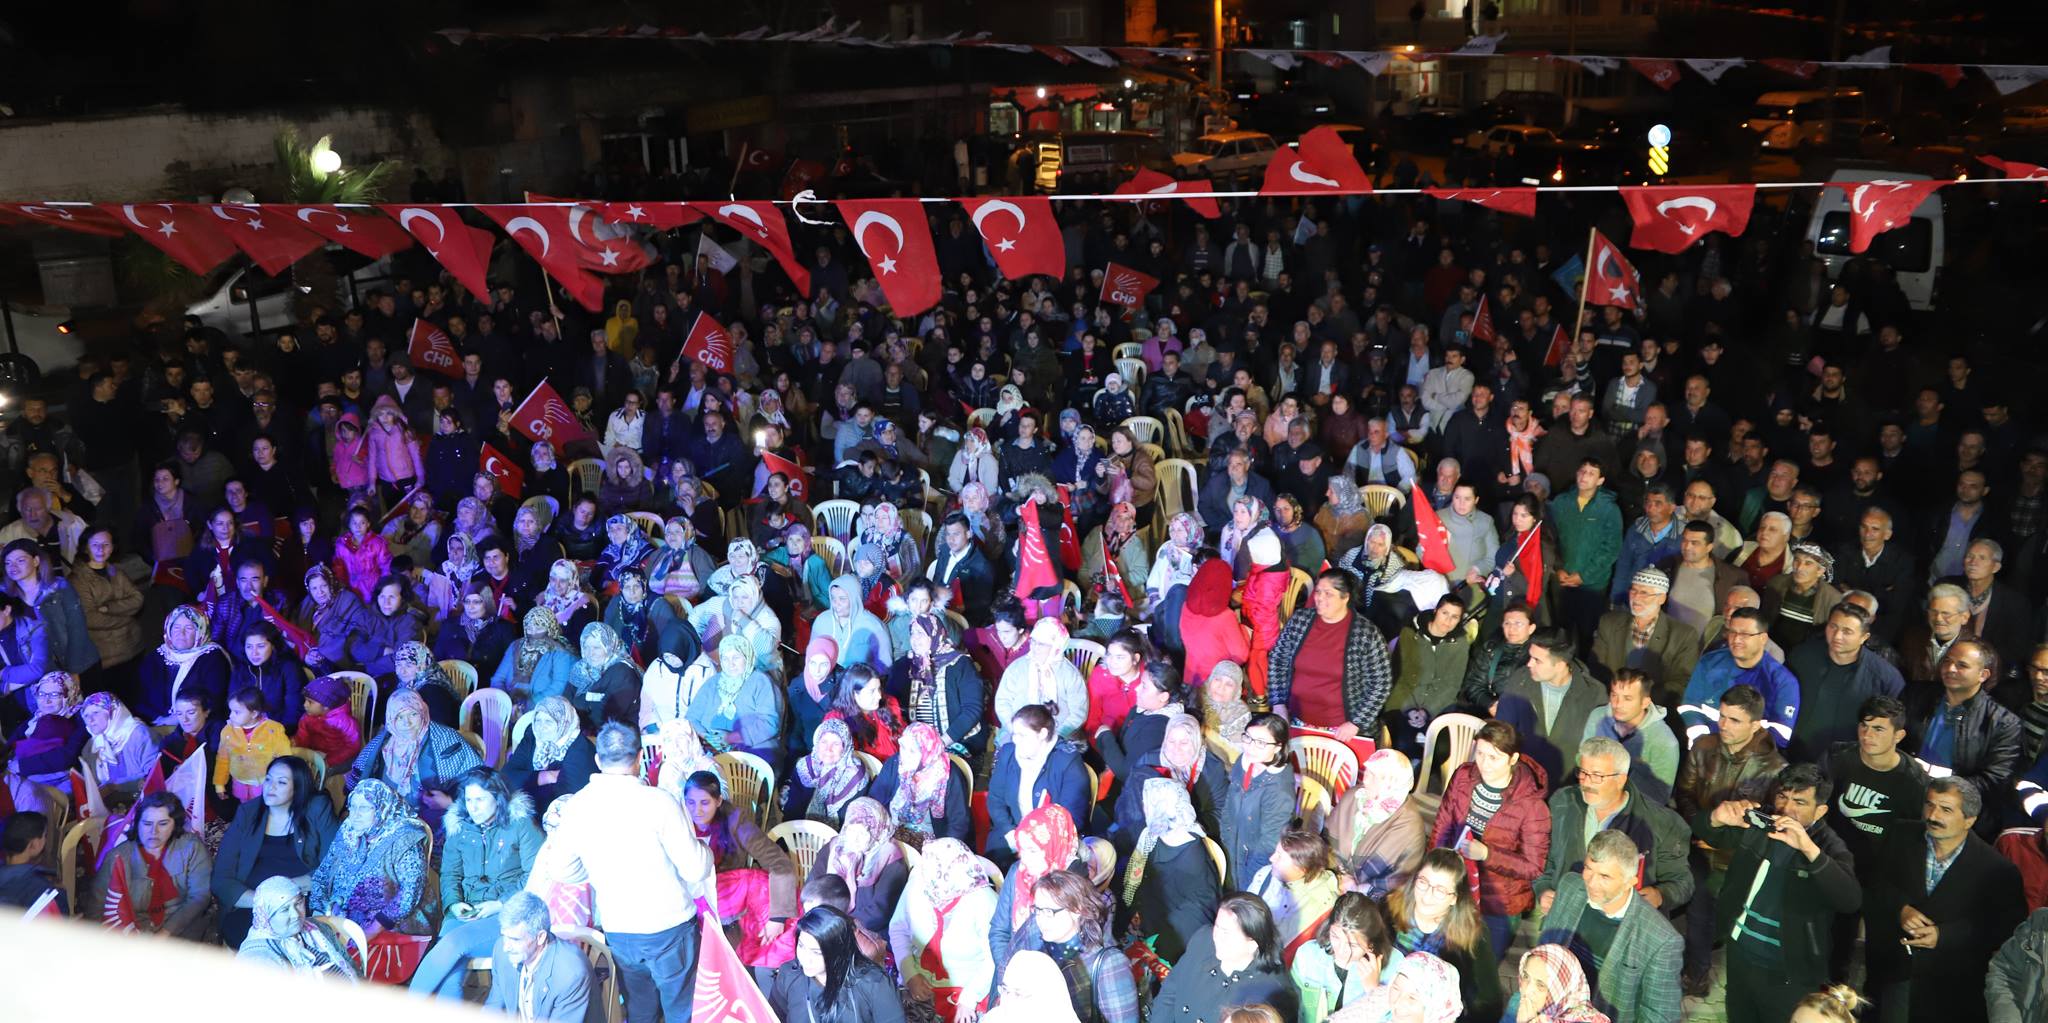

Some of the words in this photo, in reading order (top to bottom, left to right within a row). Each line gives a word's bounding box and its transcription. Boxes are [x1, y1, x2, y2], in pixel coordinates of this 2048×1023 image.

[1111, 290, 1137, 304] CHP
[423, 350, 453, 367] CHP
[697, 349, 726, 369] CHP
[1845, 782, 1885, 810] NIKE
